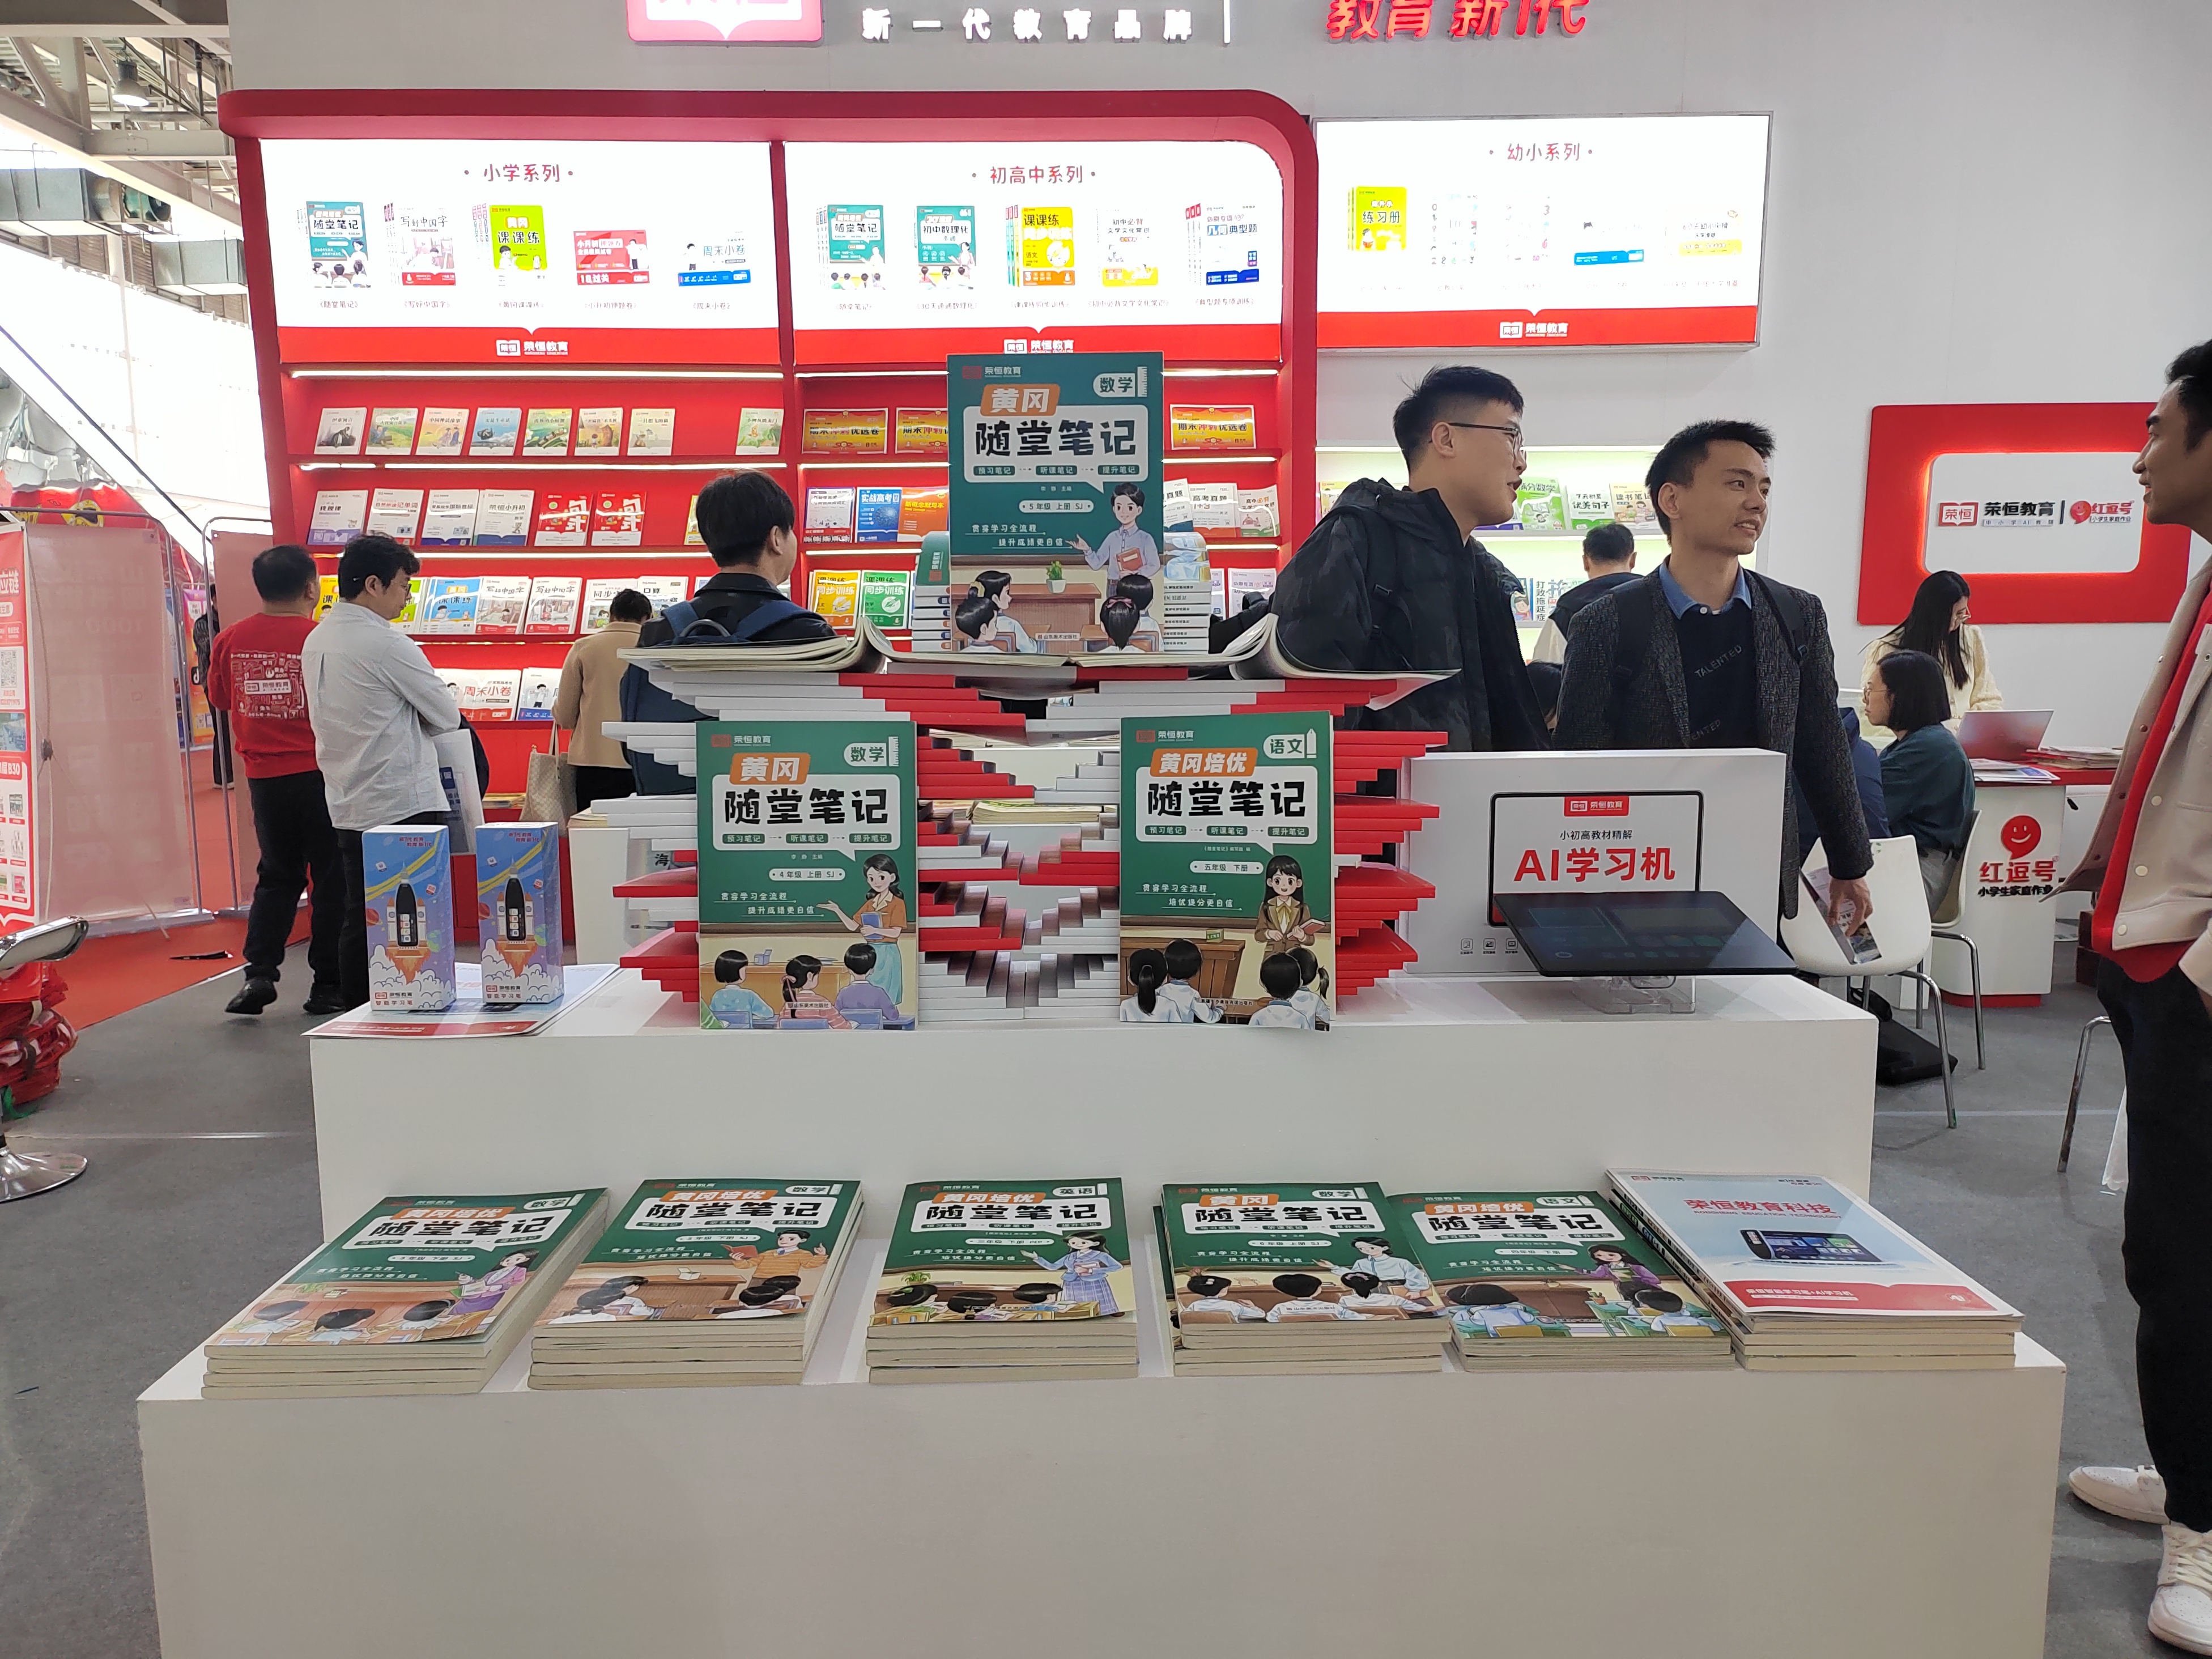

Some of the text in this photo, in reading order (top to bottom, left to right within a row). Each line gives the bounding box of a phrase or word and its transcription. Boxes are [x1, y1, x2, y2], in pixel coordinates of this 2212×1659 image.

[1507, 143, 1580, 161] 幼小系列
[484, 164, 559, 182] 小学系列
[991, 165, 1083, 184] 初高中系列
[401, 216, 448, 227] 写好中国字
[1024, 214, 1059, 226] 课课练
[1363, 211, 1399, 223] 练习册
[313, 220, 358, 229] 随堂笔记
[497, 232, 539, 244] 课课练
[703, 245, 745, 256] 周末小卷
[524, 341, 568, 351] 荣恒教育
[1031, 340, 1074, 350] 荣恒教育
[984, 367, 1022, 375] 荣恒教育
[1100, 377, 1133, 393] 数学
[990, 388, 1049, 413] 黄冈
[976, 419, 1136, 456] 随堂笔记
[1572, 501, 1610, 509] 优美句子
[1984, 501, 2055, 516] 荣恒教育
[2090, 503, 2133, 514] 红逗号
[1945, 509, 1972, 520] 荣恒
[972, 524, 1037, 533] 贯穿学习全流程
[999, 538, 1063, 547] 提升成绩更自信
[817, 586, 855, 595] 同步训练
[865, 586, 904, 595] 同步训练
[1536, 581, 1546, 622] 打败拖延症
[1695, 645, 1742, 678] TALENTED
[1158, 730, 1194, 739] 荣恒教育
[1270, 739, 1303, 754] 语文
[850, 747, 884, 762] 数学
[1159, 752, 1247, 774] 黄冈培优
[739, 757, 800, 781] 黄冈
[1148, 780, 1305, 816] 随堂笔记
[725, 788, 888, 824] 随堂笔记
[1273, 827, 1305, 836] 提升笔记
[1560, 830, 1632, 840] 小初高教材精解
[1513, 847, 1675, 882] AI学习机
[1979, 861, 2056, 883] 红逗号
[1143, 884, 1208, 893] 贯穿学习全流程
[1978, 885, 2053, 897] 小学生家庭作业
[721, 892, 788, 901] 贯穿学习全流程
[1169, 898, 1233, 907] 培优提分更自信
[748, 906, 815, 914] 提升成绩更自信
[791, 1185, 828, 1194] 数学
[671, 1191, 766, 1201] 黄冈培优
[941, 1193, 1036, 1203] 黄冈培优
[1209, 1196, 1269, 1205] 黄冈
[530, 1198, 568, 1209] 数学
[1433, 1203, 1525, 1213] 黄冈培优
[1683, 1199, 1836, 1214] 荣恒教育科技
[403, 1209, 505, 1219] 黄冈培优
[645, 1202, 822, 1219] 随堂笔记
[926, 1203, 1098, 1220] 随堂笔记
[1195, 1207, 1367, 1223] 随堂笔记
[368, 1216, 555, 1237] 随堂笔记
[1428, 1215, 1603, 1231] 随堂笔记
